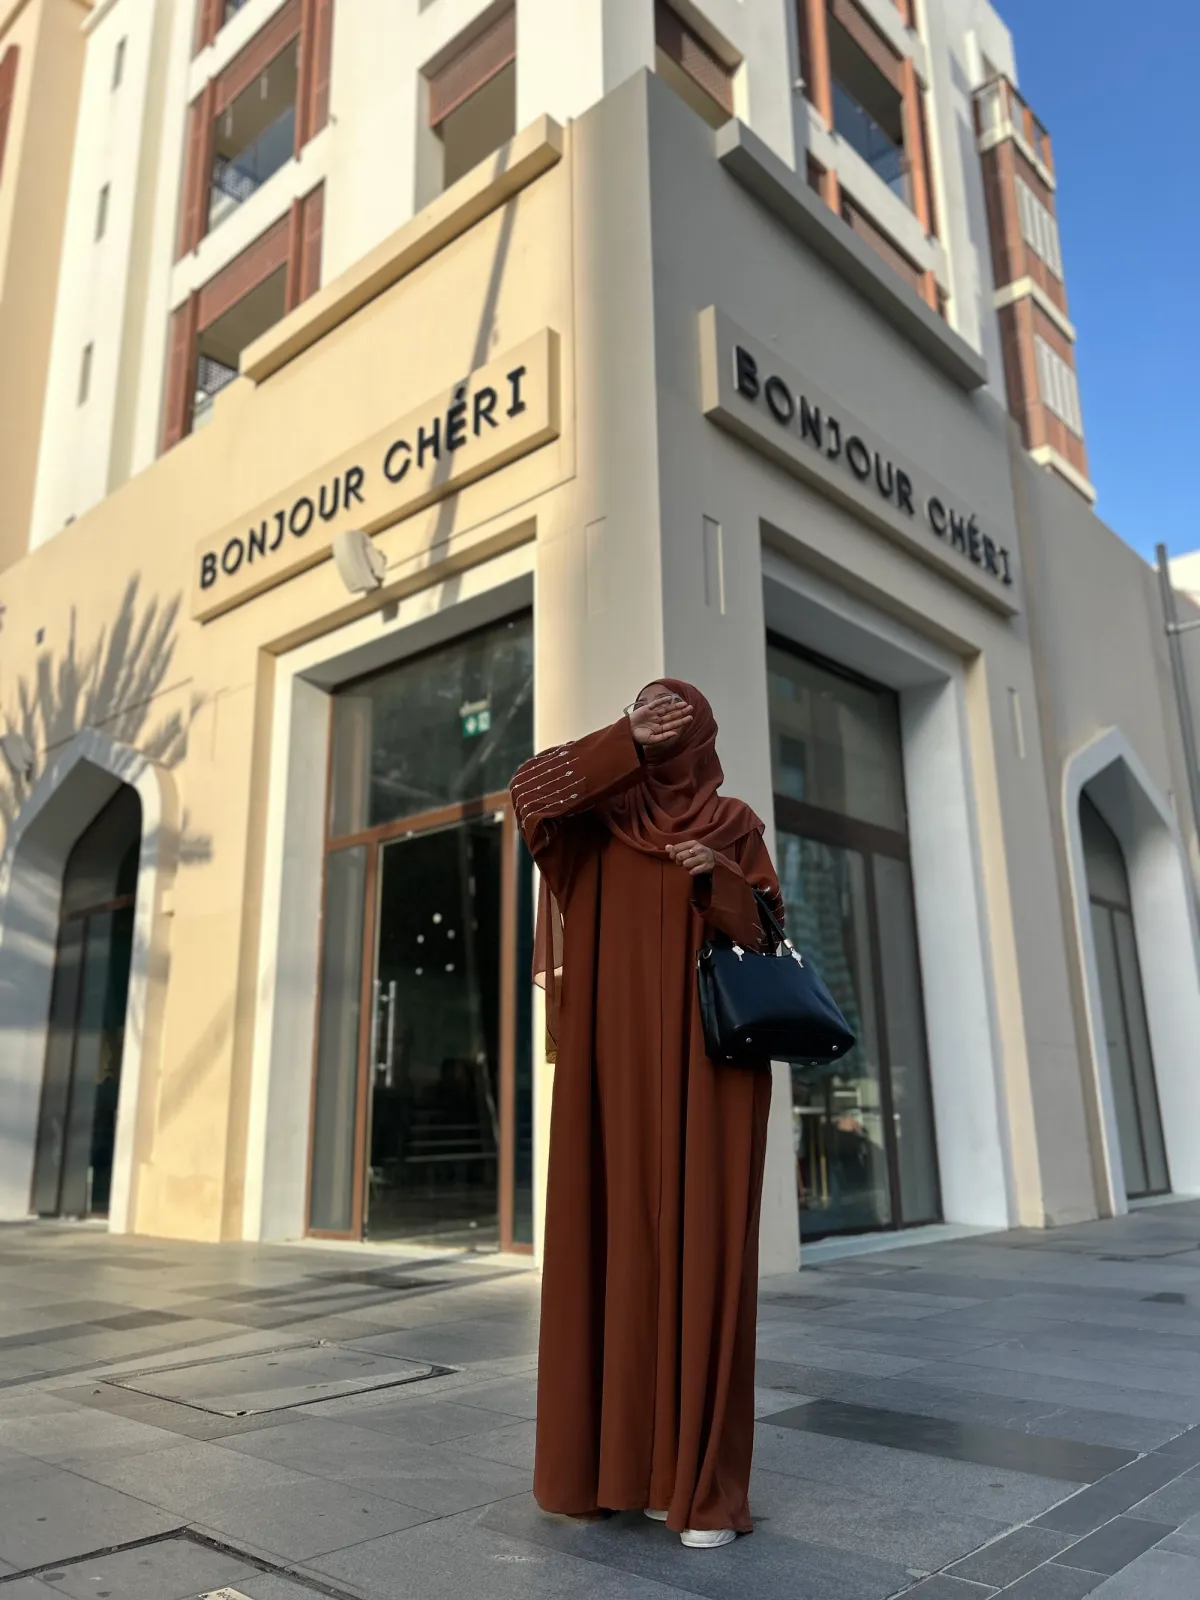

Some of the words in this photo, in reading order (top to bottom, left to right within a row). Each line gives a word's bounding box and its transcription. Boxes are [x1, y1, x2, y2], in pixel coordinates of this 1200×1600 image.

[200, 466, 365, 589] BONJOUR
[383, 366, 527, 483] CHÉRI
[734, 345, 915, 516] BONJOUR
[926, 496, 1012, 585] CHÉRI
